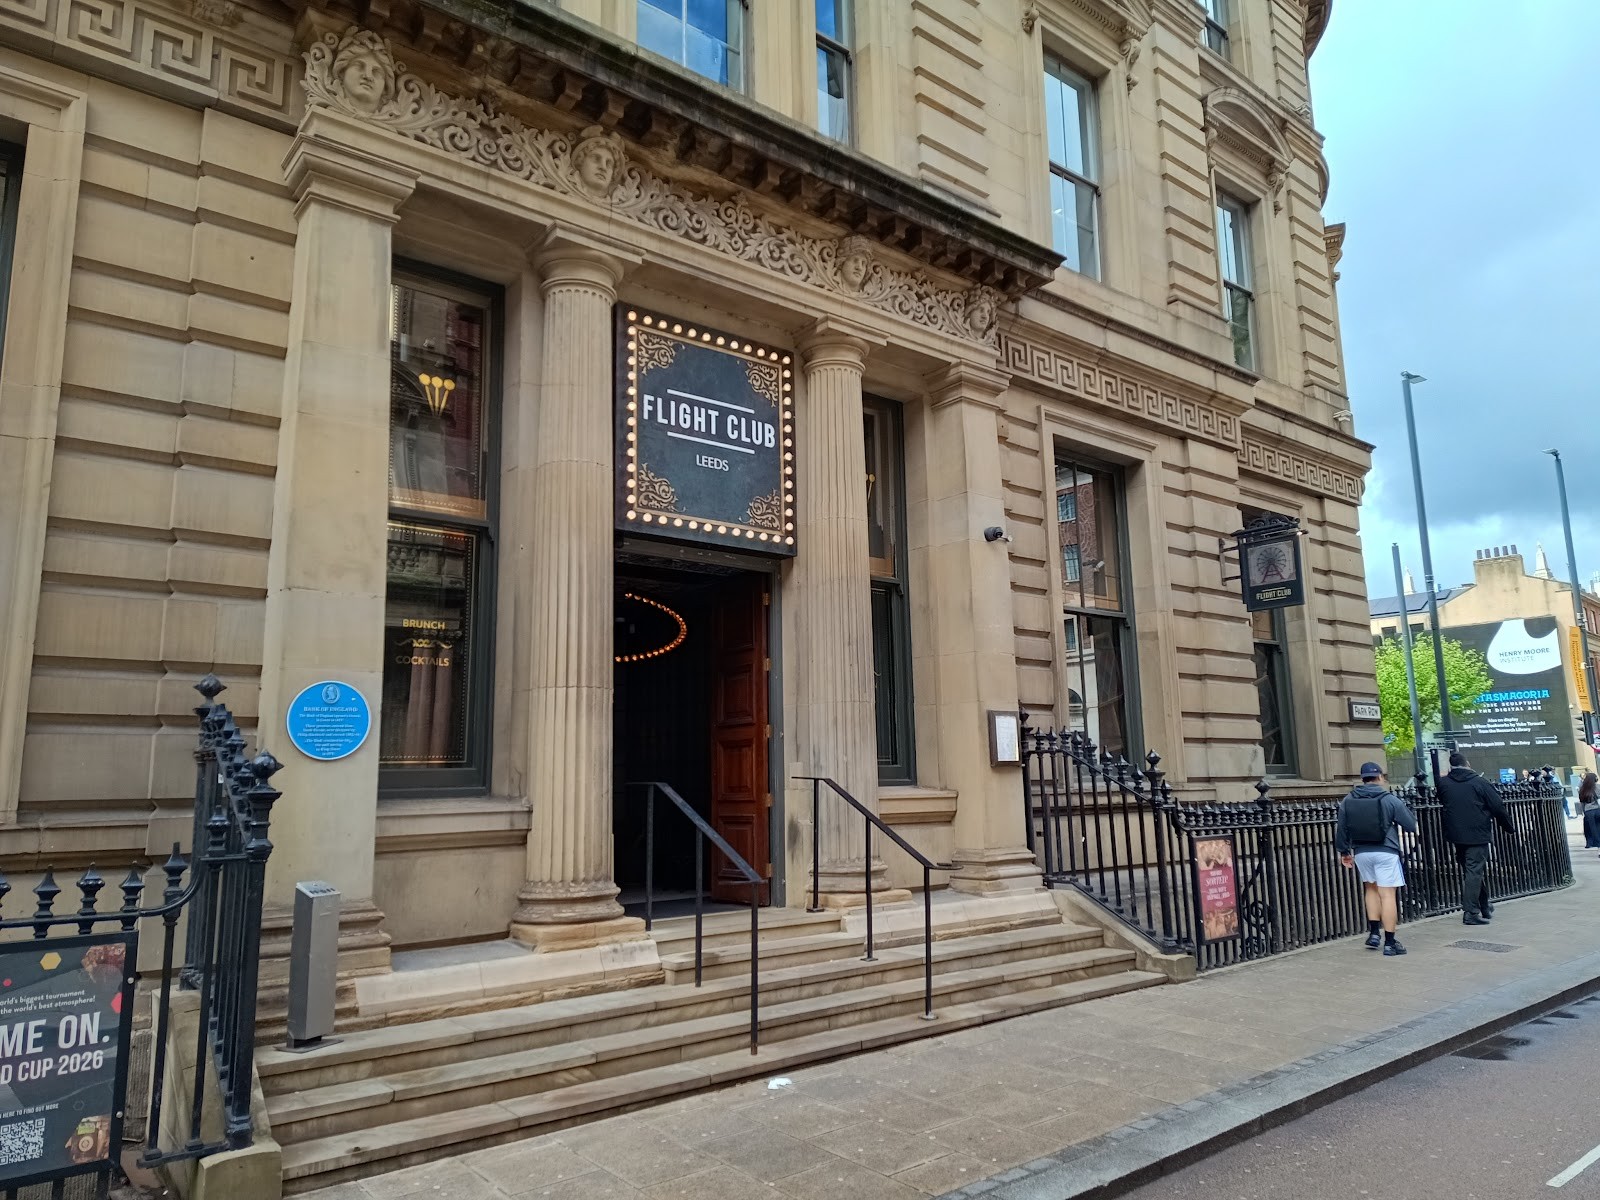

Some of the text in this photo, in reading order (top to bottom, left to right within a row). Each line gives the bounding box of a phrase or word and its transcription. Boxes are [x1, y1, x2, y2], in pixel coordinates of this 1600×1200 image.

[643, 394, 776, 448] FLIGHT CLUB
[696, 454, 729, 472] LEEDS
[1255, 588, 1292, 600] FLIGHT CLUB
[402, 618, 446, 630] BRUNCH
[1499, 647, 1550, 658] HENRY MOORE
[395, 655, 450, 667] COCKTAILS
[1499, 655, 1534, 664] INSTITUTE
[1501, 699, 1541, 707] SCULPTURE
[1354, 705, 1368, 716] PARK
[20, 995, 44, 1005] biggest
[45, 989, 85, 1001] tournament
[13, 1002, 37, 1013] world's
[38, 1000, 53, 1009] best
[54, 995, 96, 1008] atmosphere!
[58, 1011, 110, 1049] ON.
[17, 1057, 54, 1083] CUP
[57, 1050, 104, 1076] 2026
[23, 1107, 35, 1115] FIND
[35, 1105, 45, 1113] OUT
[45, 1102, 59, 1111] MORE
